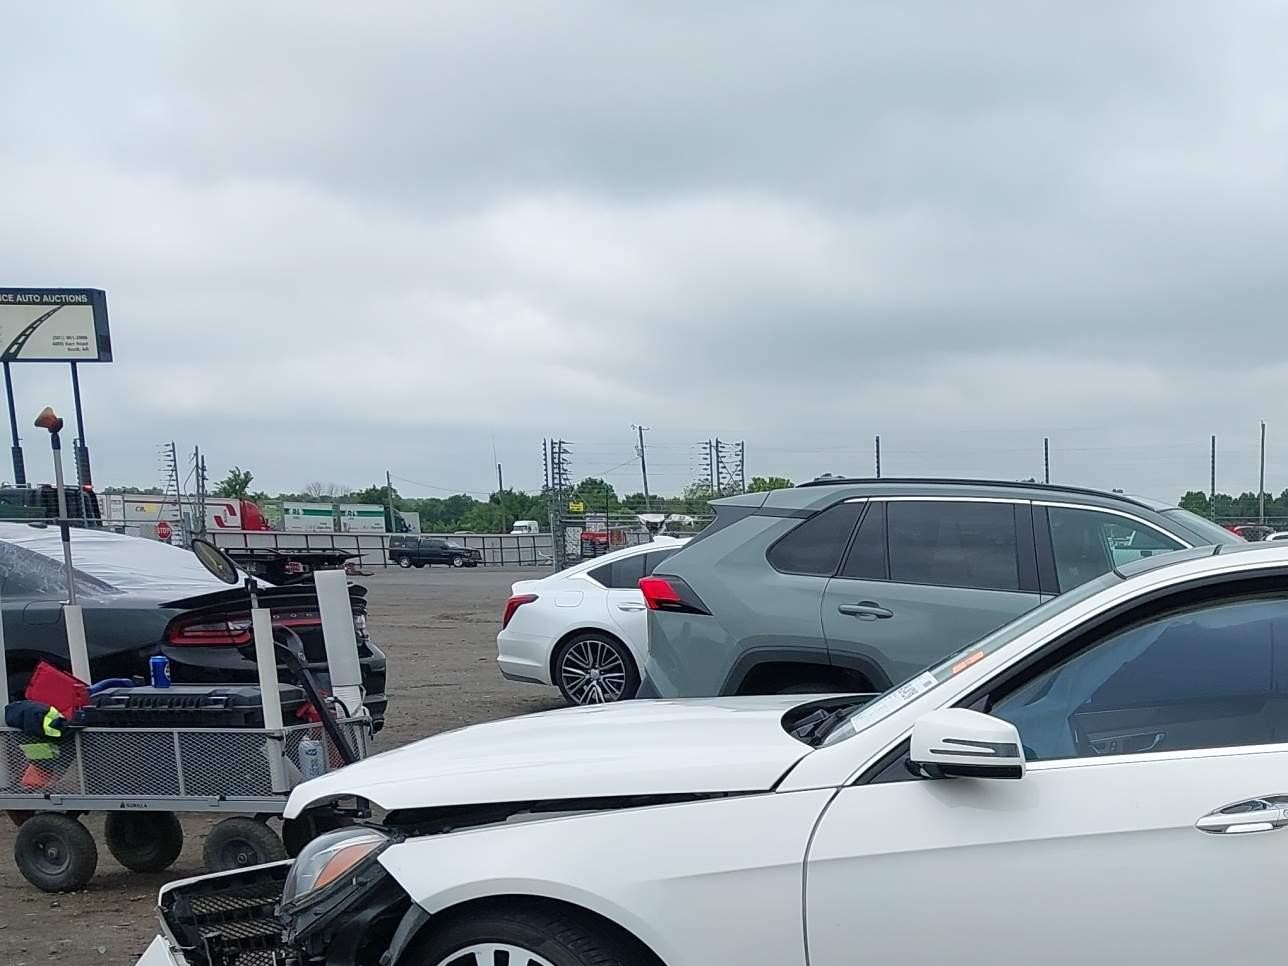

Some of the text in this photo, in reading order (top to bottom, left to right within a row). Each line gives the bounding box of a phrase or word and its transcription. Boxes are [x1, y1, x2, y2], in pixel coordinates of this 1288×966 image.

[0, 294, 88, 303] CE AUTO AUCTIONS
